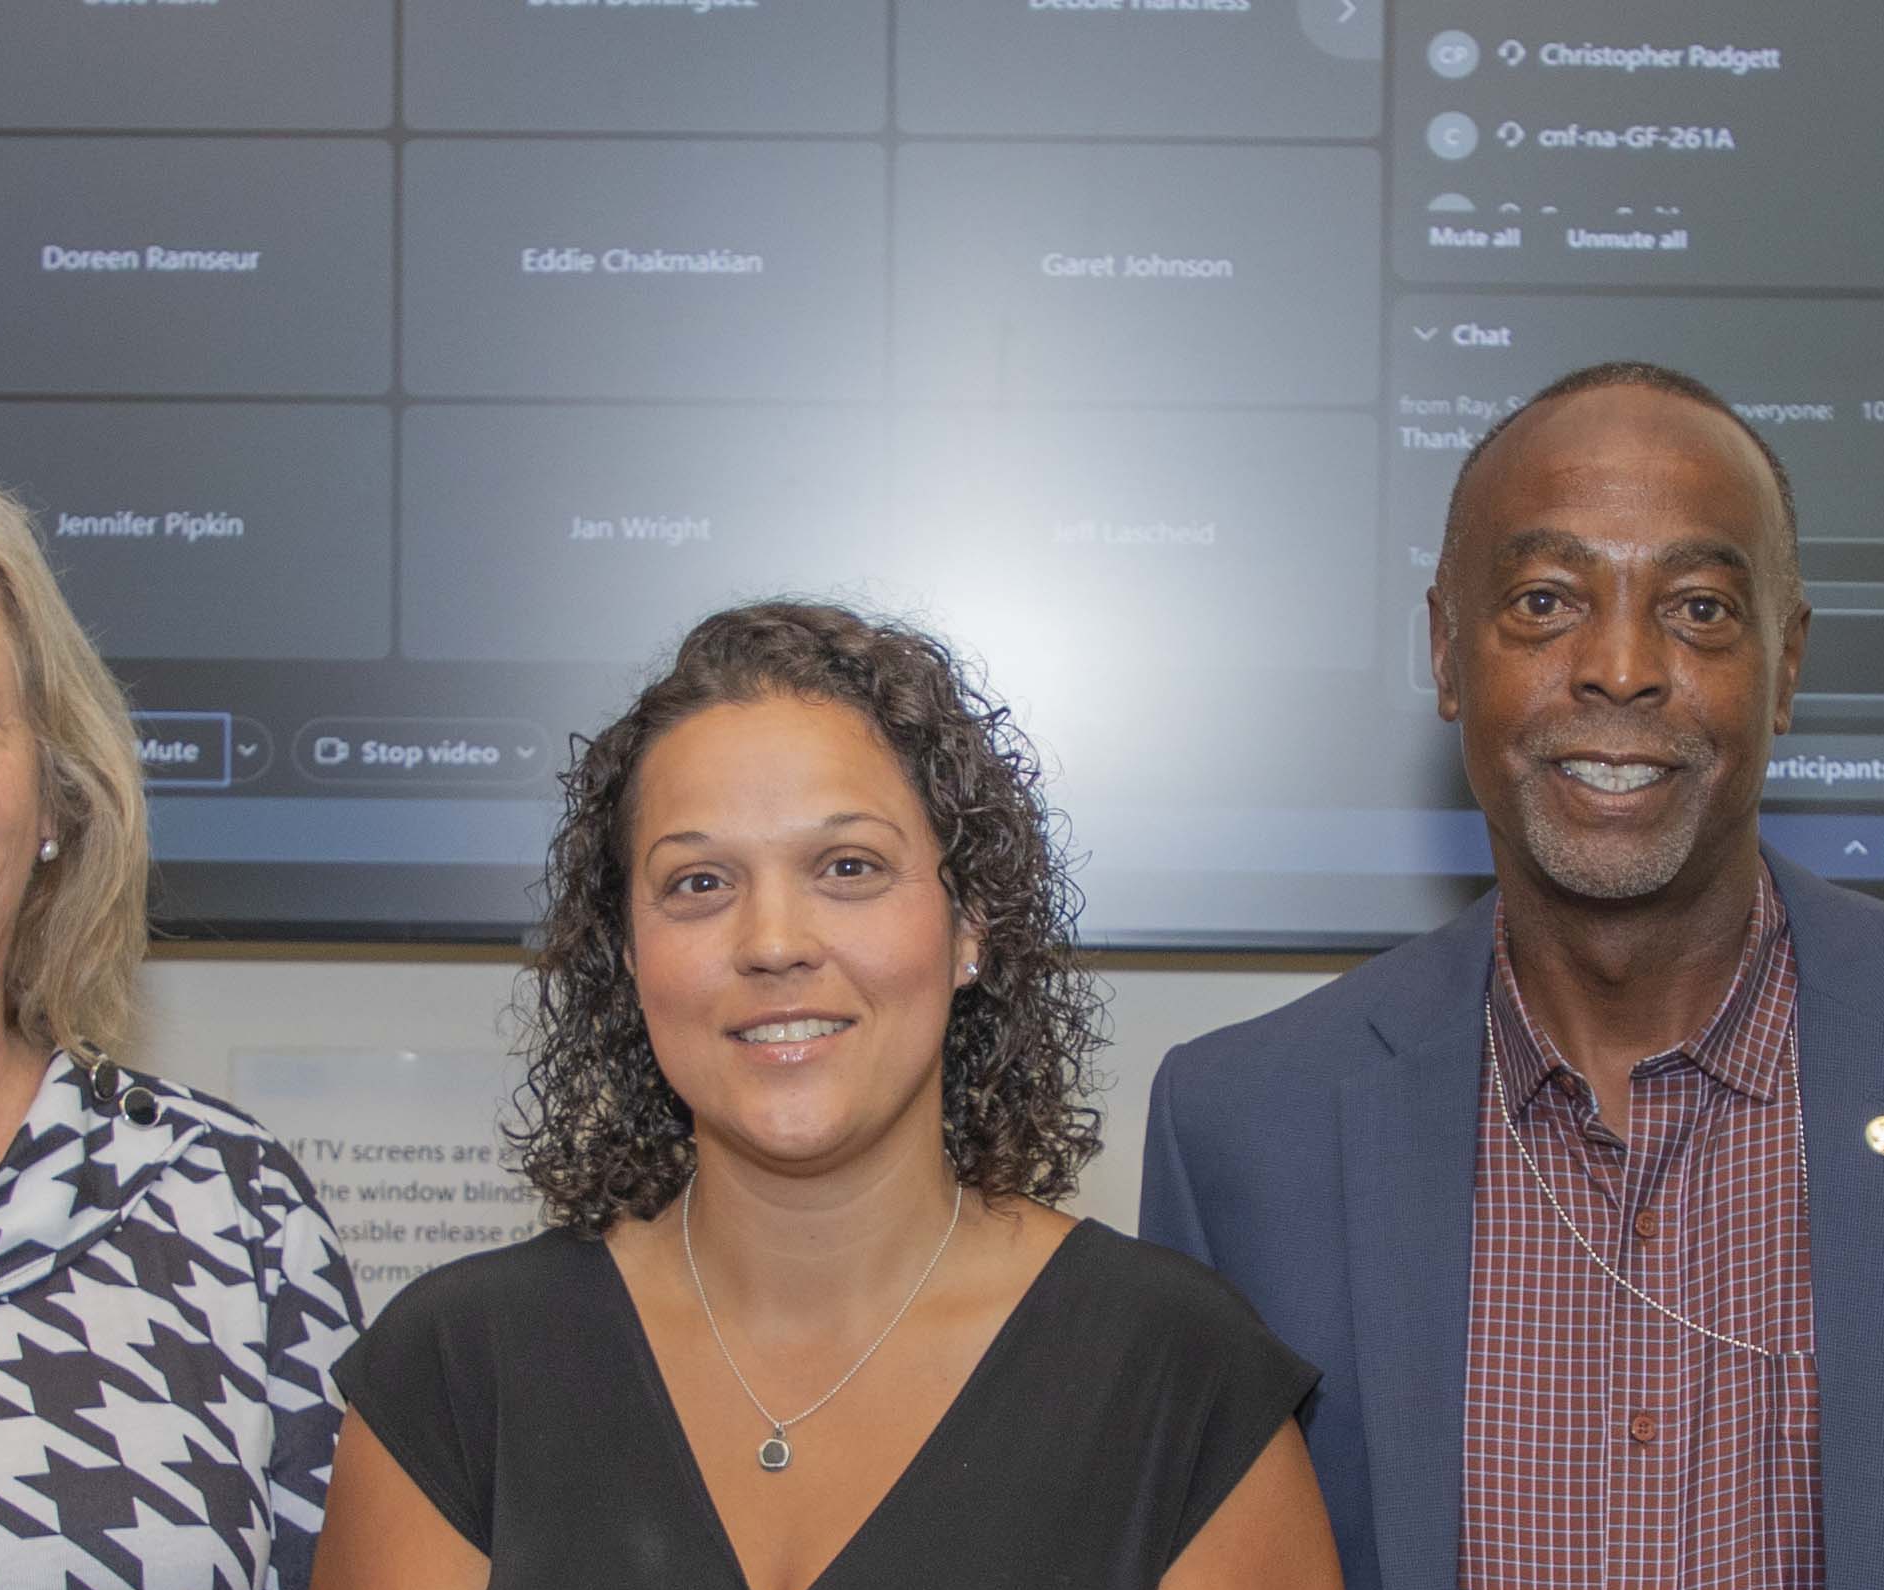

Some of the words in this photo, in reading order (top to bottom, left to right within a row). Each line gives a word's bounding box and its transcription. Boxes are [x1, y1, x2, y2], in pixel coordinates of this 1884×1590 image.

[1539, 42, 1681, 71] Christopher
[1688, 44, 1780, 74] Padgett
[1538, 125, 1734, 148] cnf-na-GF-261A
[1429, 227, 1489, 247] Mute
[1493, 227, 1521, 247] all
[1567, 228, 1654, 248] Unmute
[1659, 229, 1687, 249] all
[42, 245, 139, 270] Doreen
[146, 246, 261, 270] Ramseur
[521, 248, 595, 272] Eddie
[602, 248, 763, 272] Chakmakian
[1043, 254, 1115, 276] Garet
[1124, 254, 1233, 277] Johnson
[1452, 322, 1512, 346] Chat
[1399, 394, 1450, 415] from
[57, 511, 160, 537] Jennifer
[165, 511, 244, 543] Pipkin
[570, 516, 613, 539] Jan
[620, 515, 711, 546] Wright
[361, 736, 423, 769] Stop
[427, 737, 500, 765] video
[289, 1138, 307, 1160] If
[313, 1138, 345, 1160] TV
[352, 1144, 445, 1162] screens
[452, 1145, 492, 1163] are
[316, 1180, 350, 1200] he
[358, 1180, 456, 1202] window
[338, 1220, 407, 1241] ssible
[415, 1220, 502, 1242] release
